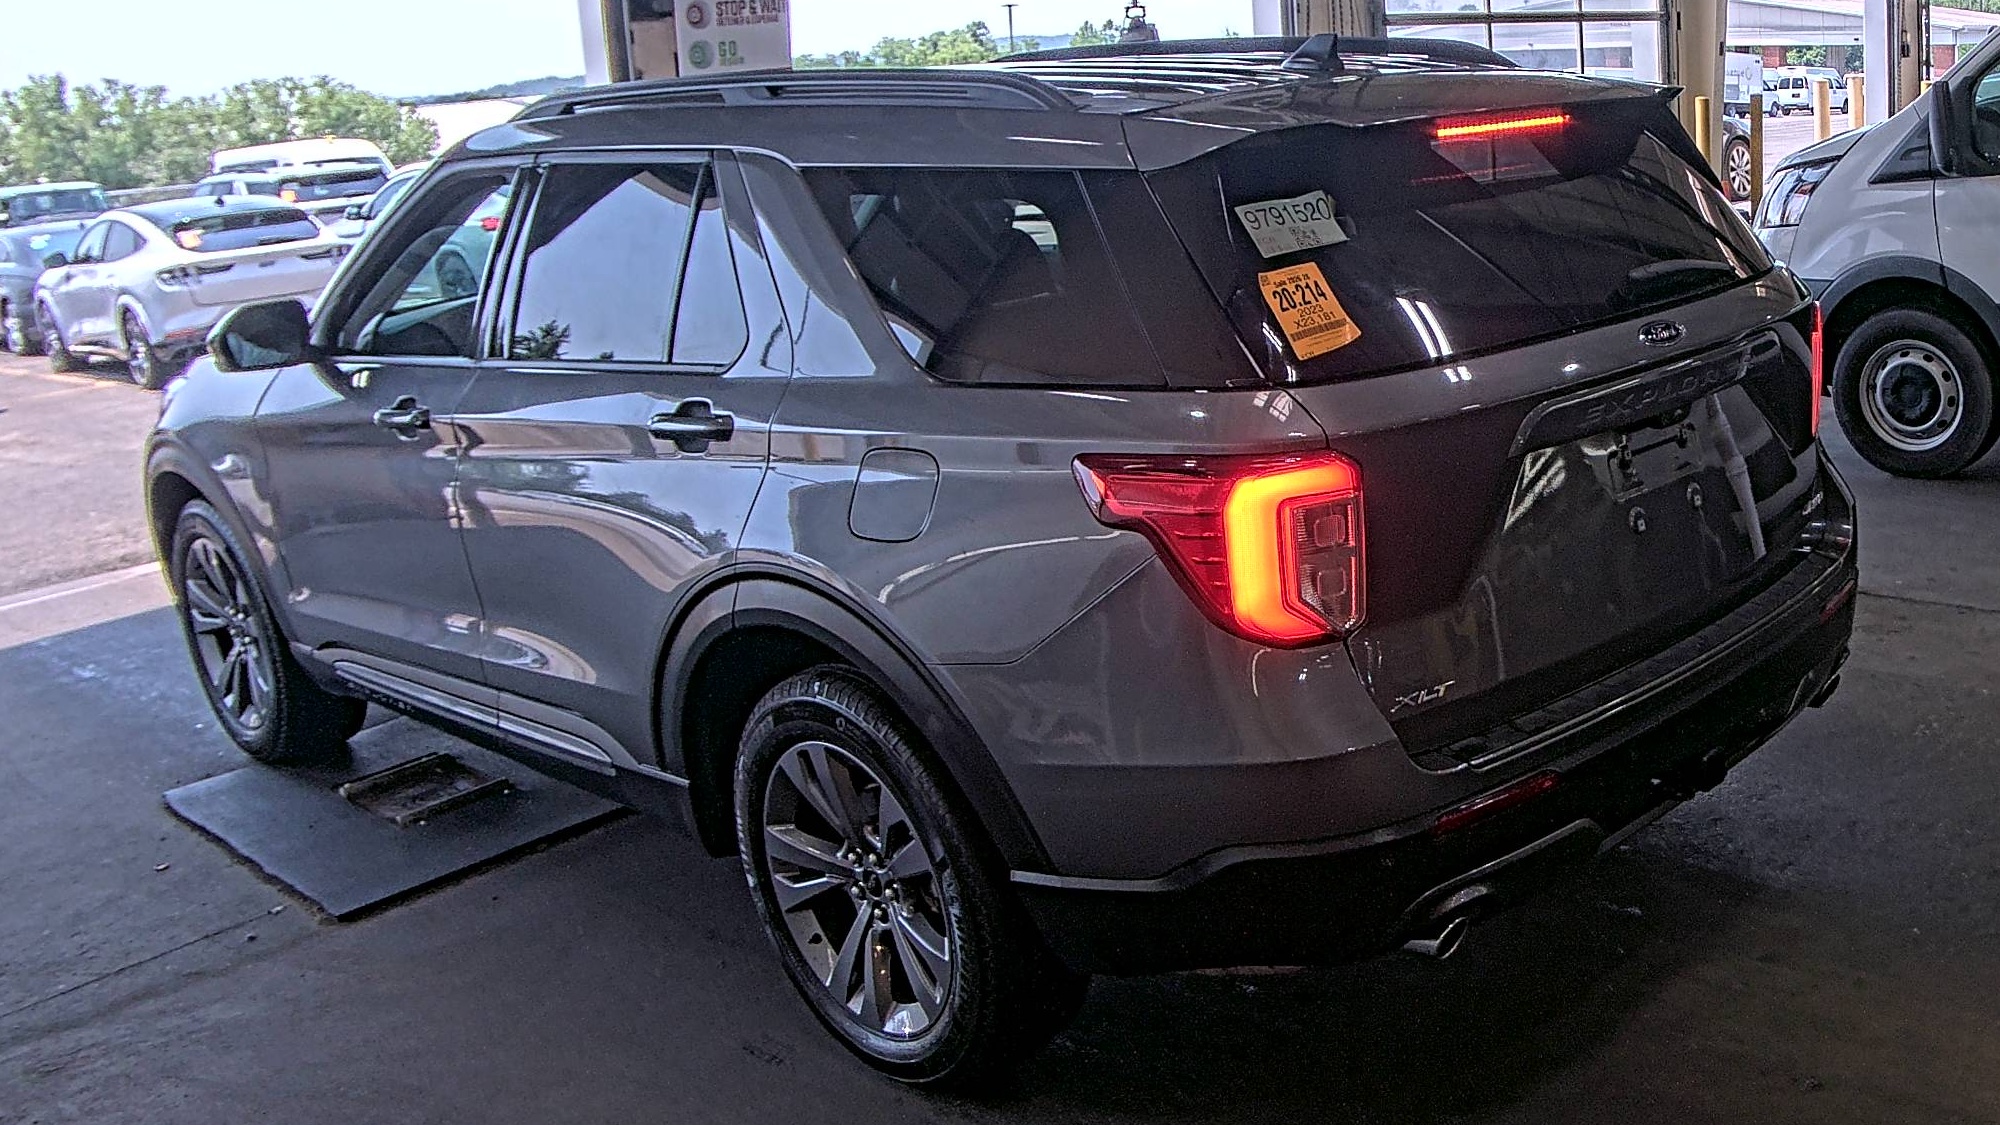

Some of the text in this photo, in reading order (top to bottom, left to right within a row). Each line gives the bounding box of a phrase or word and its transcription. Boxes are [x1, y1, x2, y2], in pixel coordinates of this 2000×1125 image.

[716, 1, 746, 17] STOP
[718, 40, 737, 57] GO
[1244, 197, 1331, 230] 9791520
[1272, 280, 1329, 312] 20:214
[1293, 311, 1337, 330] X23,181
[1297, 304, 1324, 318] 2023
[1390, 680, 1456, 713] XLT
